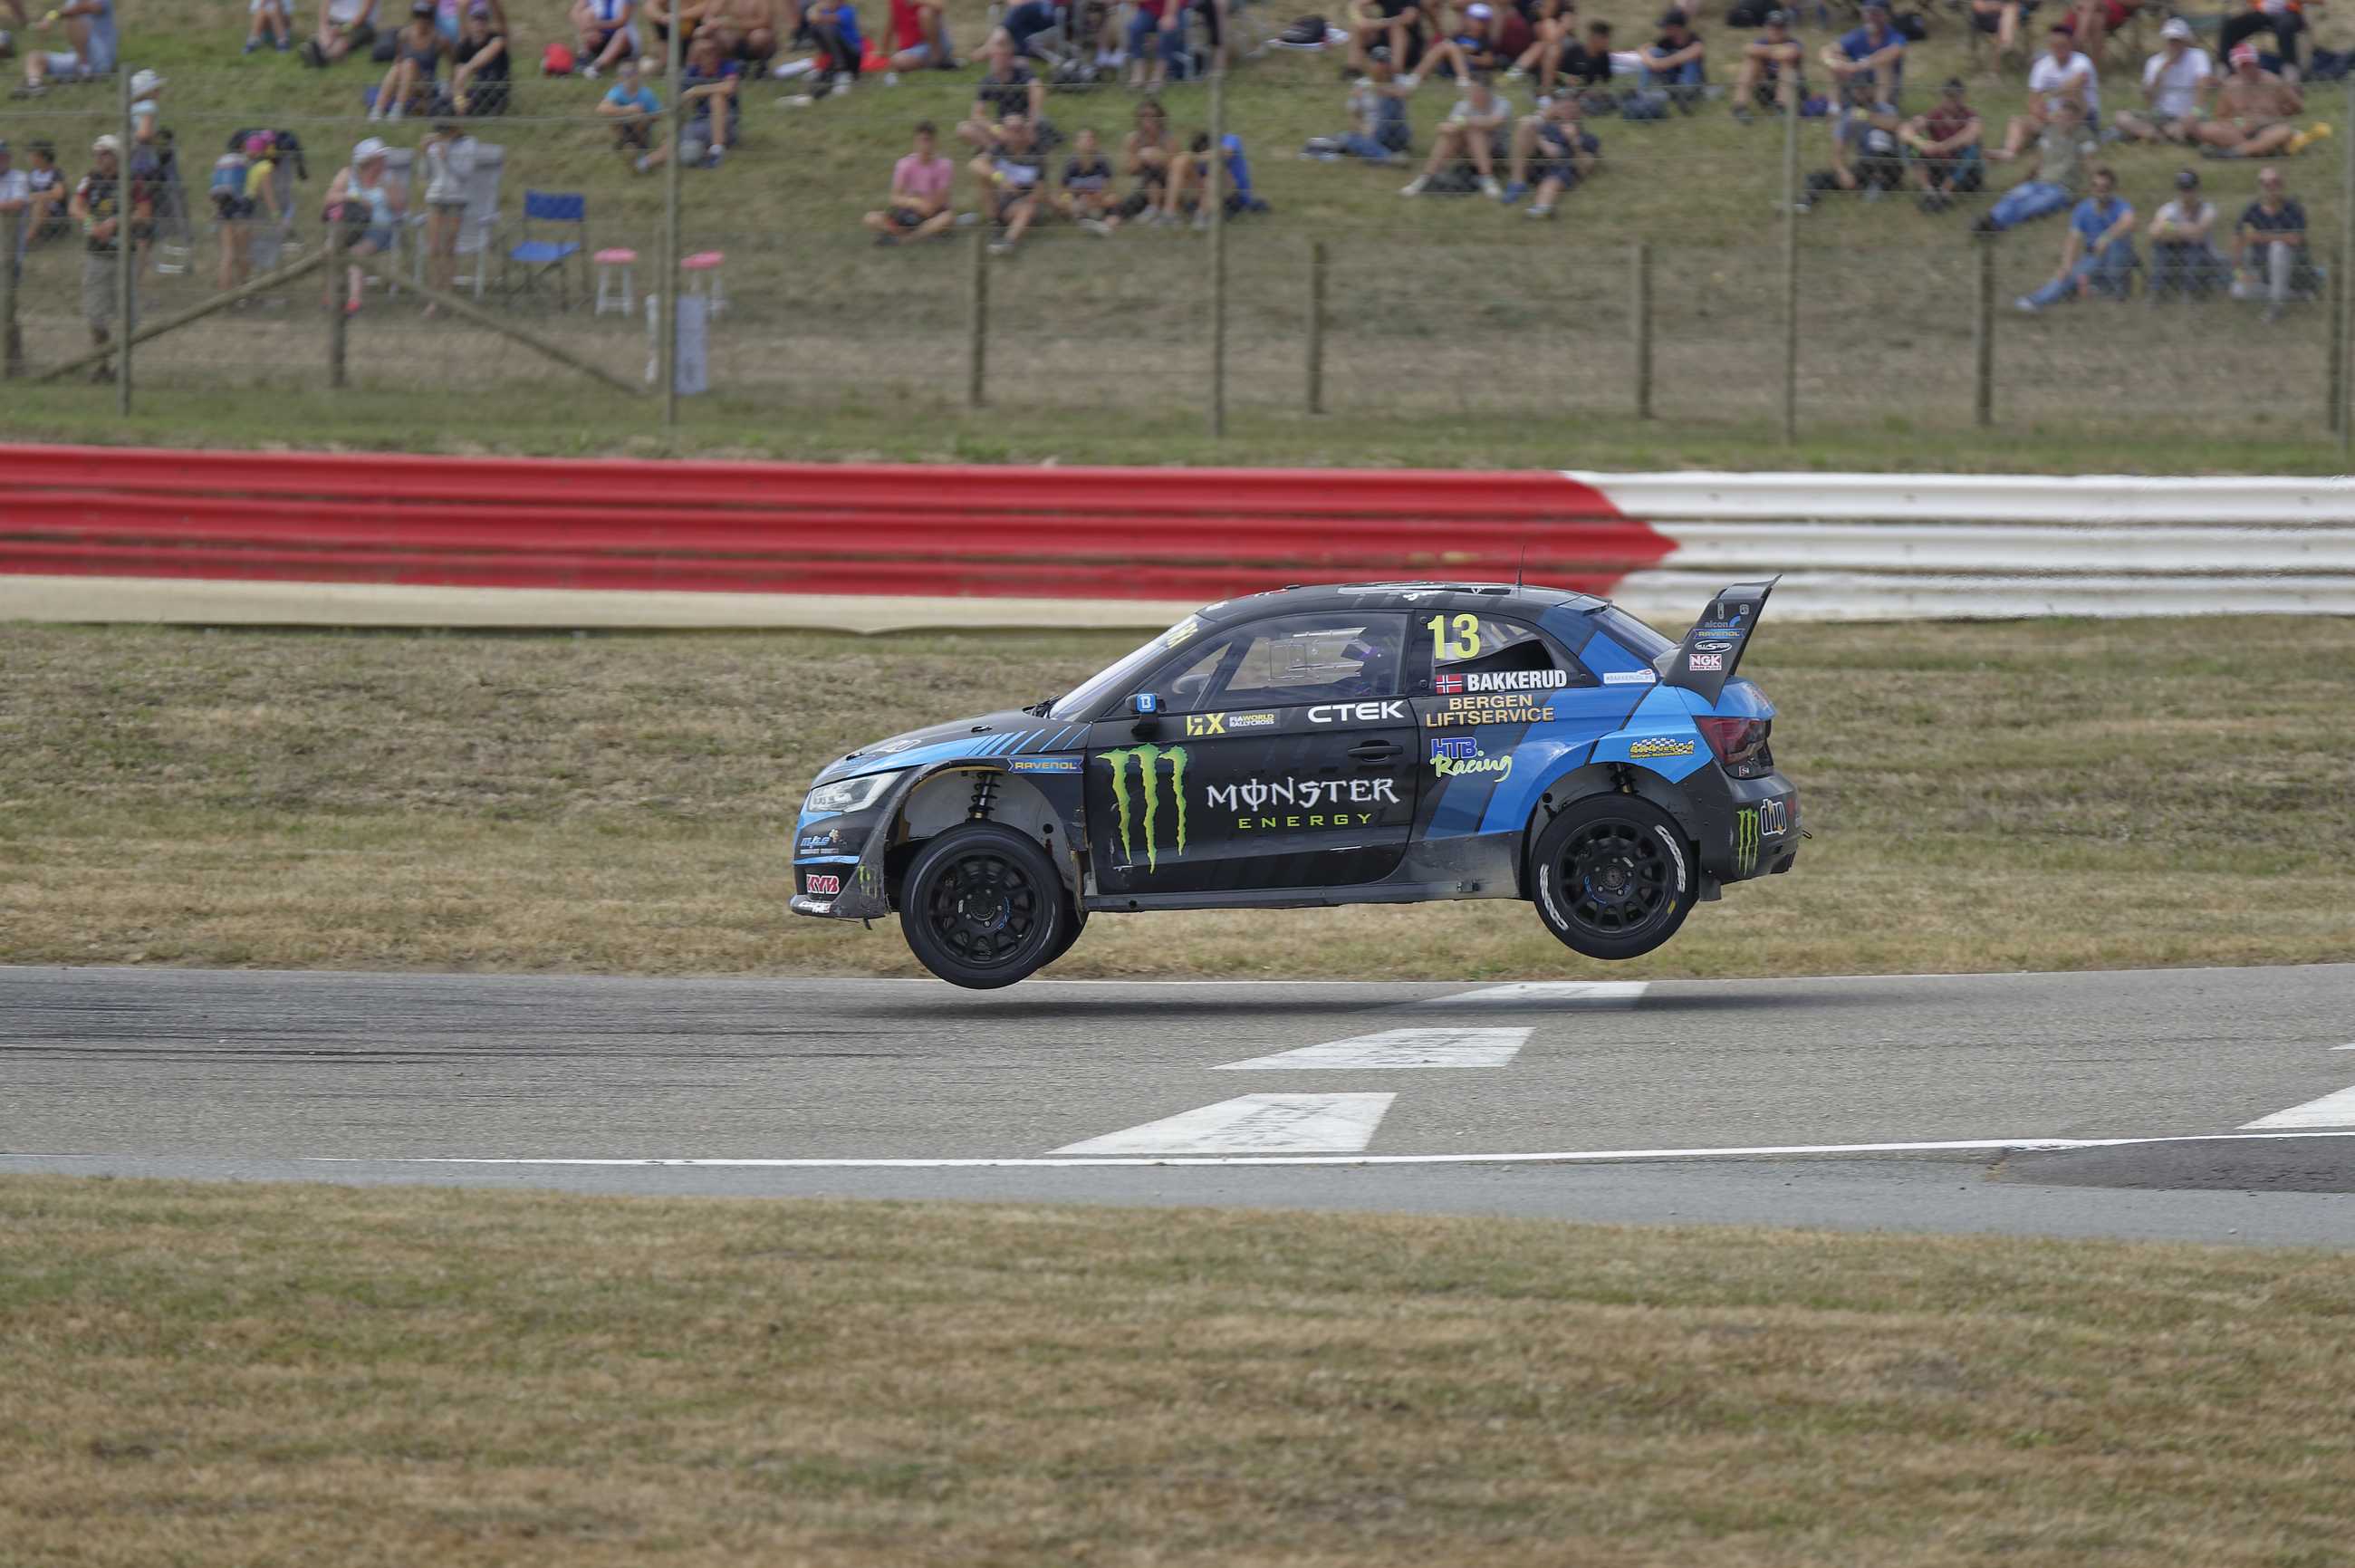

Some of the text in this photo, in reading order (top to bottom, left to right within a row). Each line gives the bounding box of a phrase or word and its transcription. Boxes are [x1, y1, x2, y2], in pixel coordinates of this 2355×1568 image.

[1427, 613, 1480, 659] 13
[1690, 655, 1720, 667] NGK
[1467, 669, 1567, 691] BAKKERUD
[1307, 700, 1405, 723] CTEK
[1449, 694, 1533, 710] BERGEN
[1229, 719, 1274, 727] RALLYCROSS
[1426, 707, 1554, 727] LIFTSERVICE
[1014, 762, 1078, 770] RAVENOL
[1429, 750, 1513, 783] Racing
[1206, 776, 1400, 812] MONSTER
[1238, 813, 1372, 829] ENERGY
[806, 873, 840, 895] KYB
